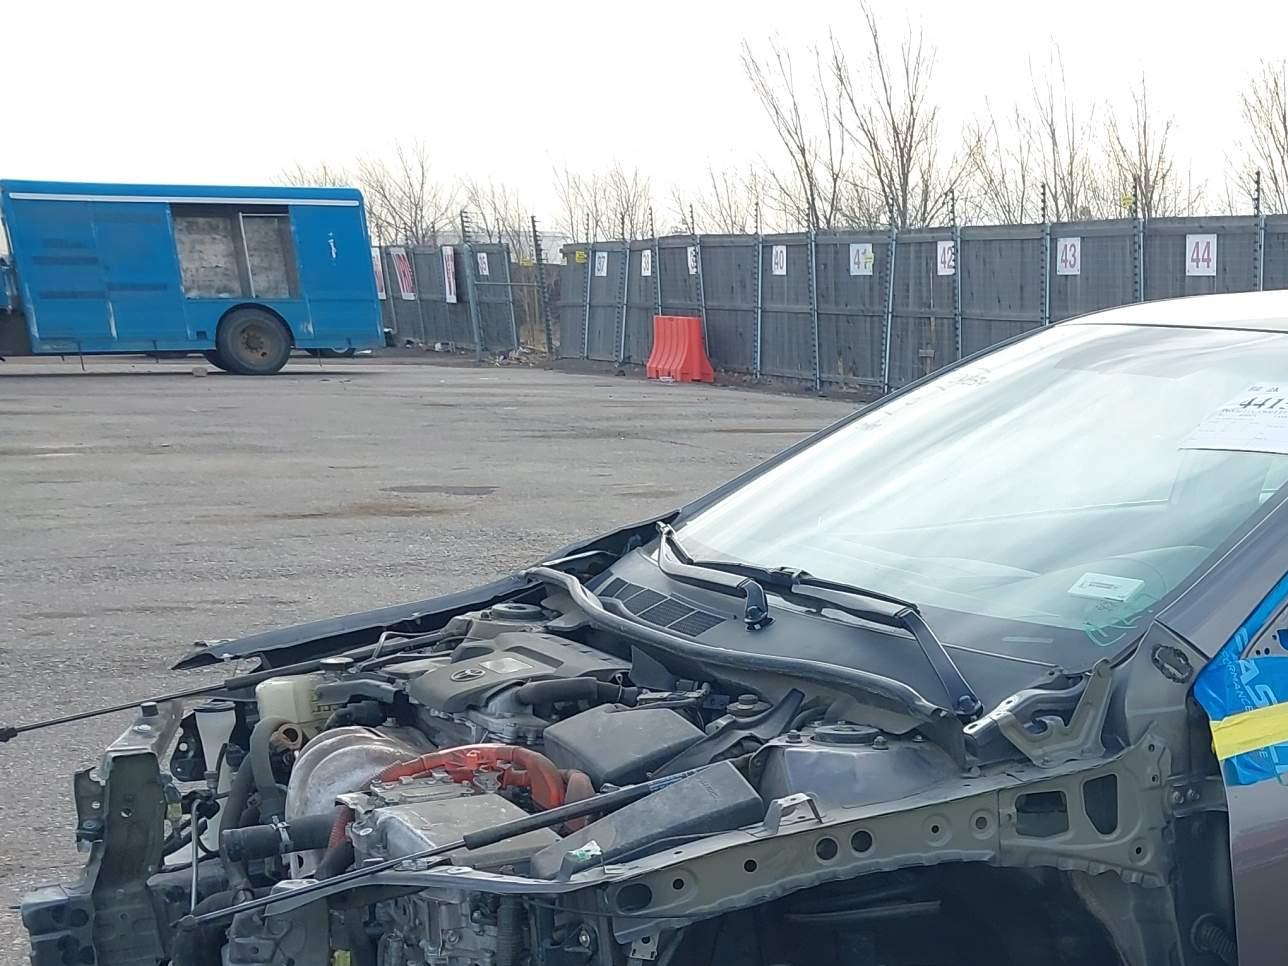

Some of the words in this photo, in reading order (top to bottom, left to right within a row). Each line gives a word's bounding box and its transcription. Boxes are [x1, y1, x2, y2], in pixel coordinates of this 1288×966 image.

[774, 248, 784, 270] 40
[940, 246, 955, 269] 42
[1061, 243, 1077, 269] 43
[1191, 241, 1211, 269] 44
